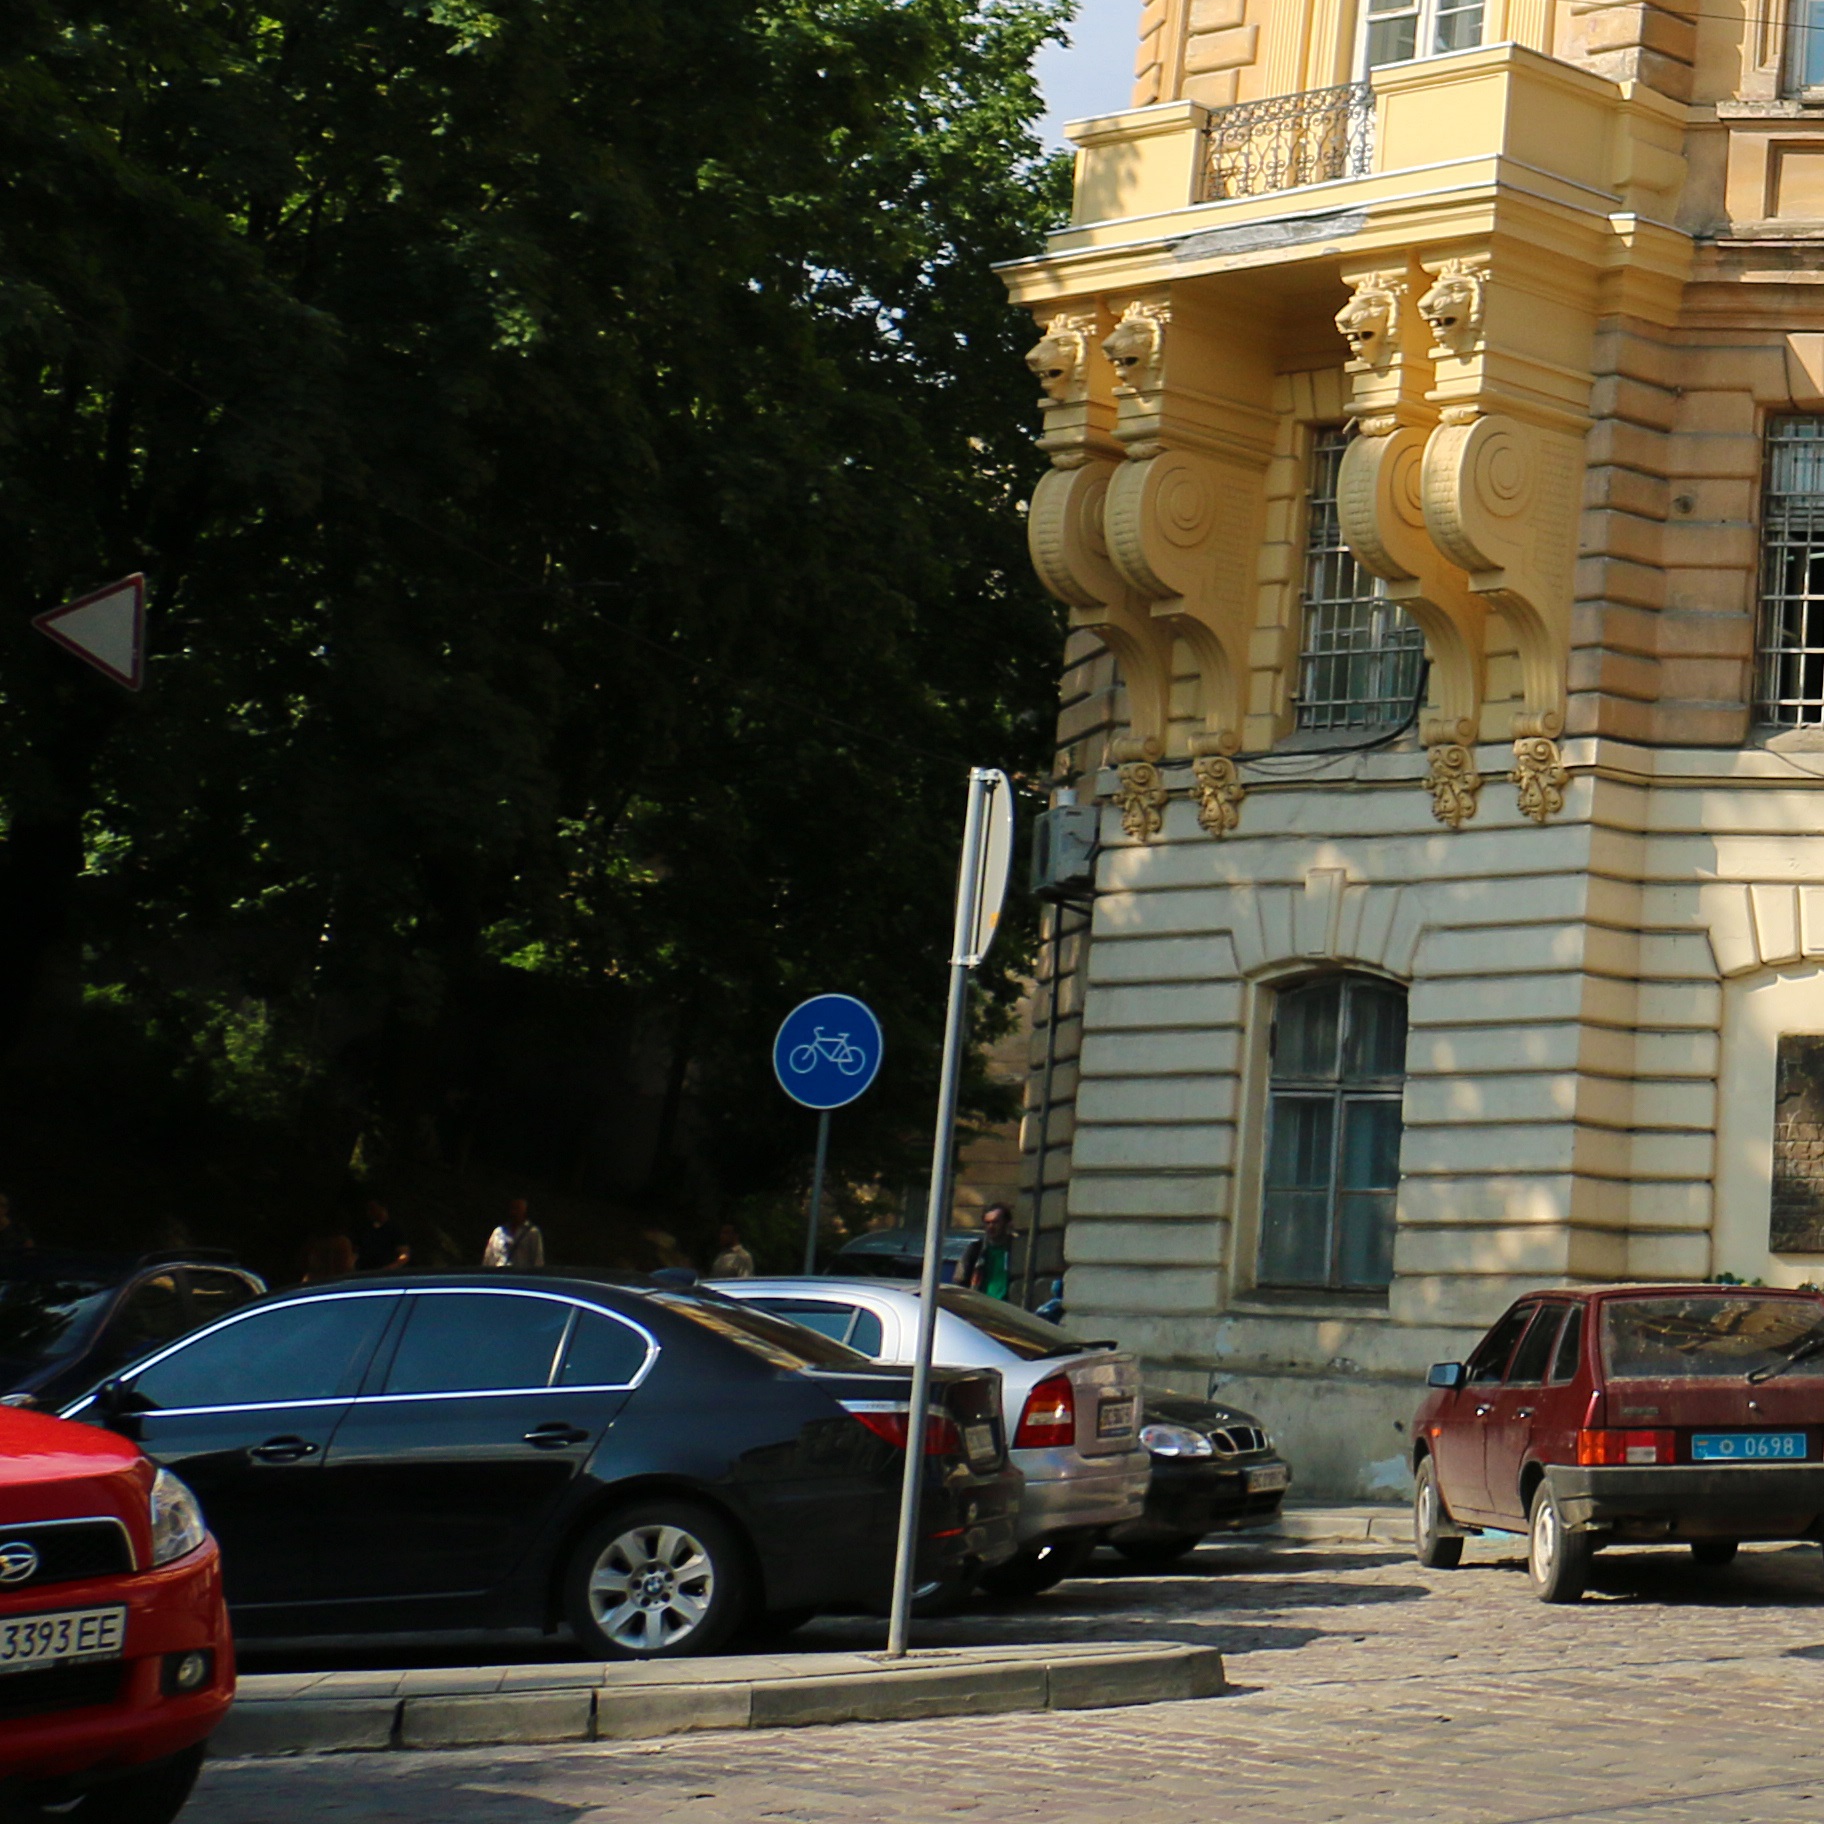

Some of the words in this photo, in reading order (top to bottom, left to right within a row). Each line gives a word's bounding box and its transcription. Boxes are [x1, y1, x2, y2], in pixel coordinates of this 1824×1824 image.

[1744, 1437, 1795, 1456] 0698
[1, 1619, 73, 1660] 3393
[77, 1614, 119, 1651] EE
